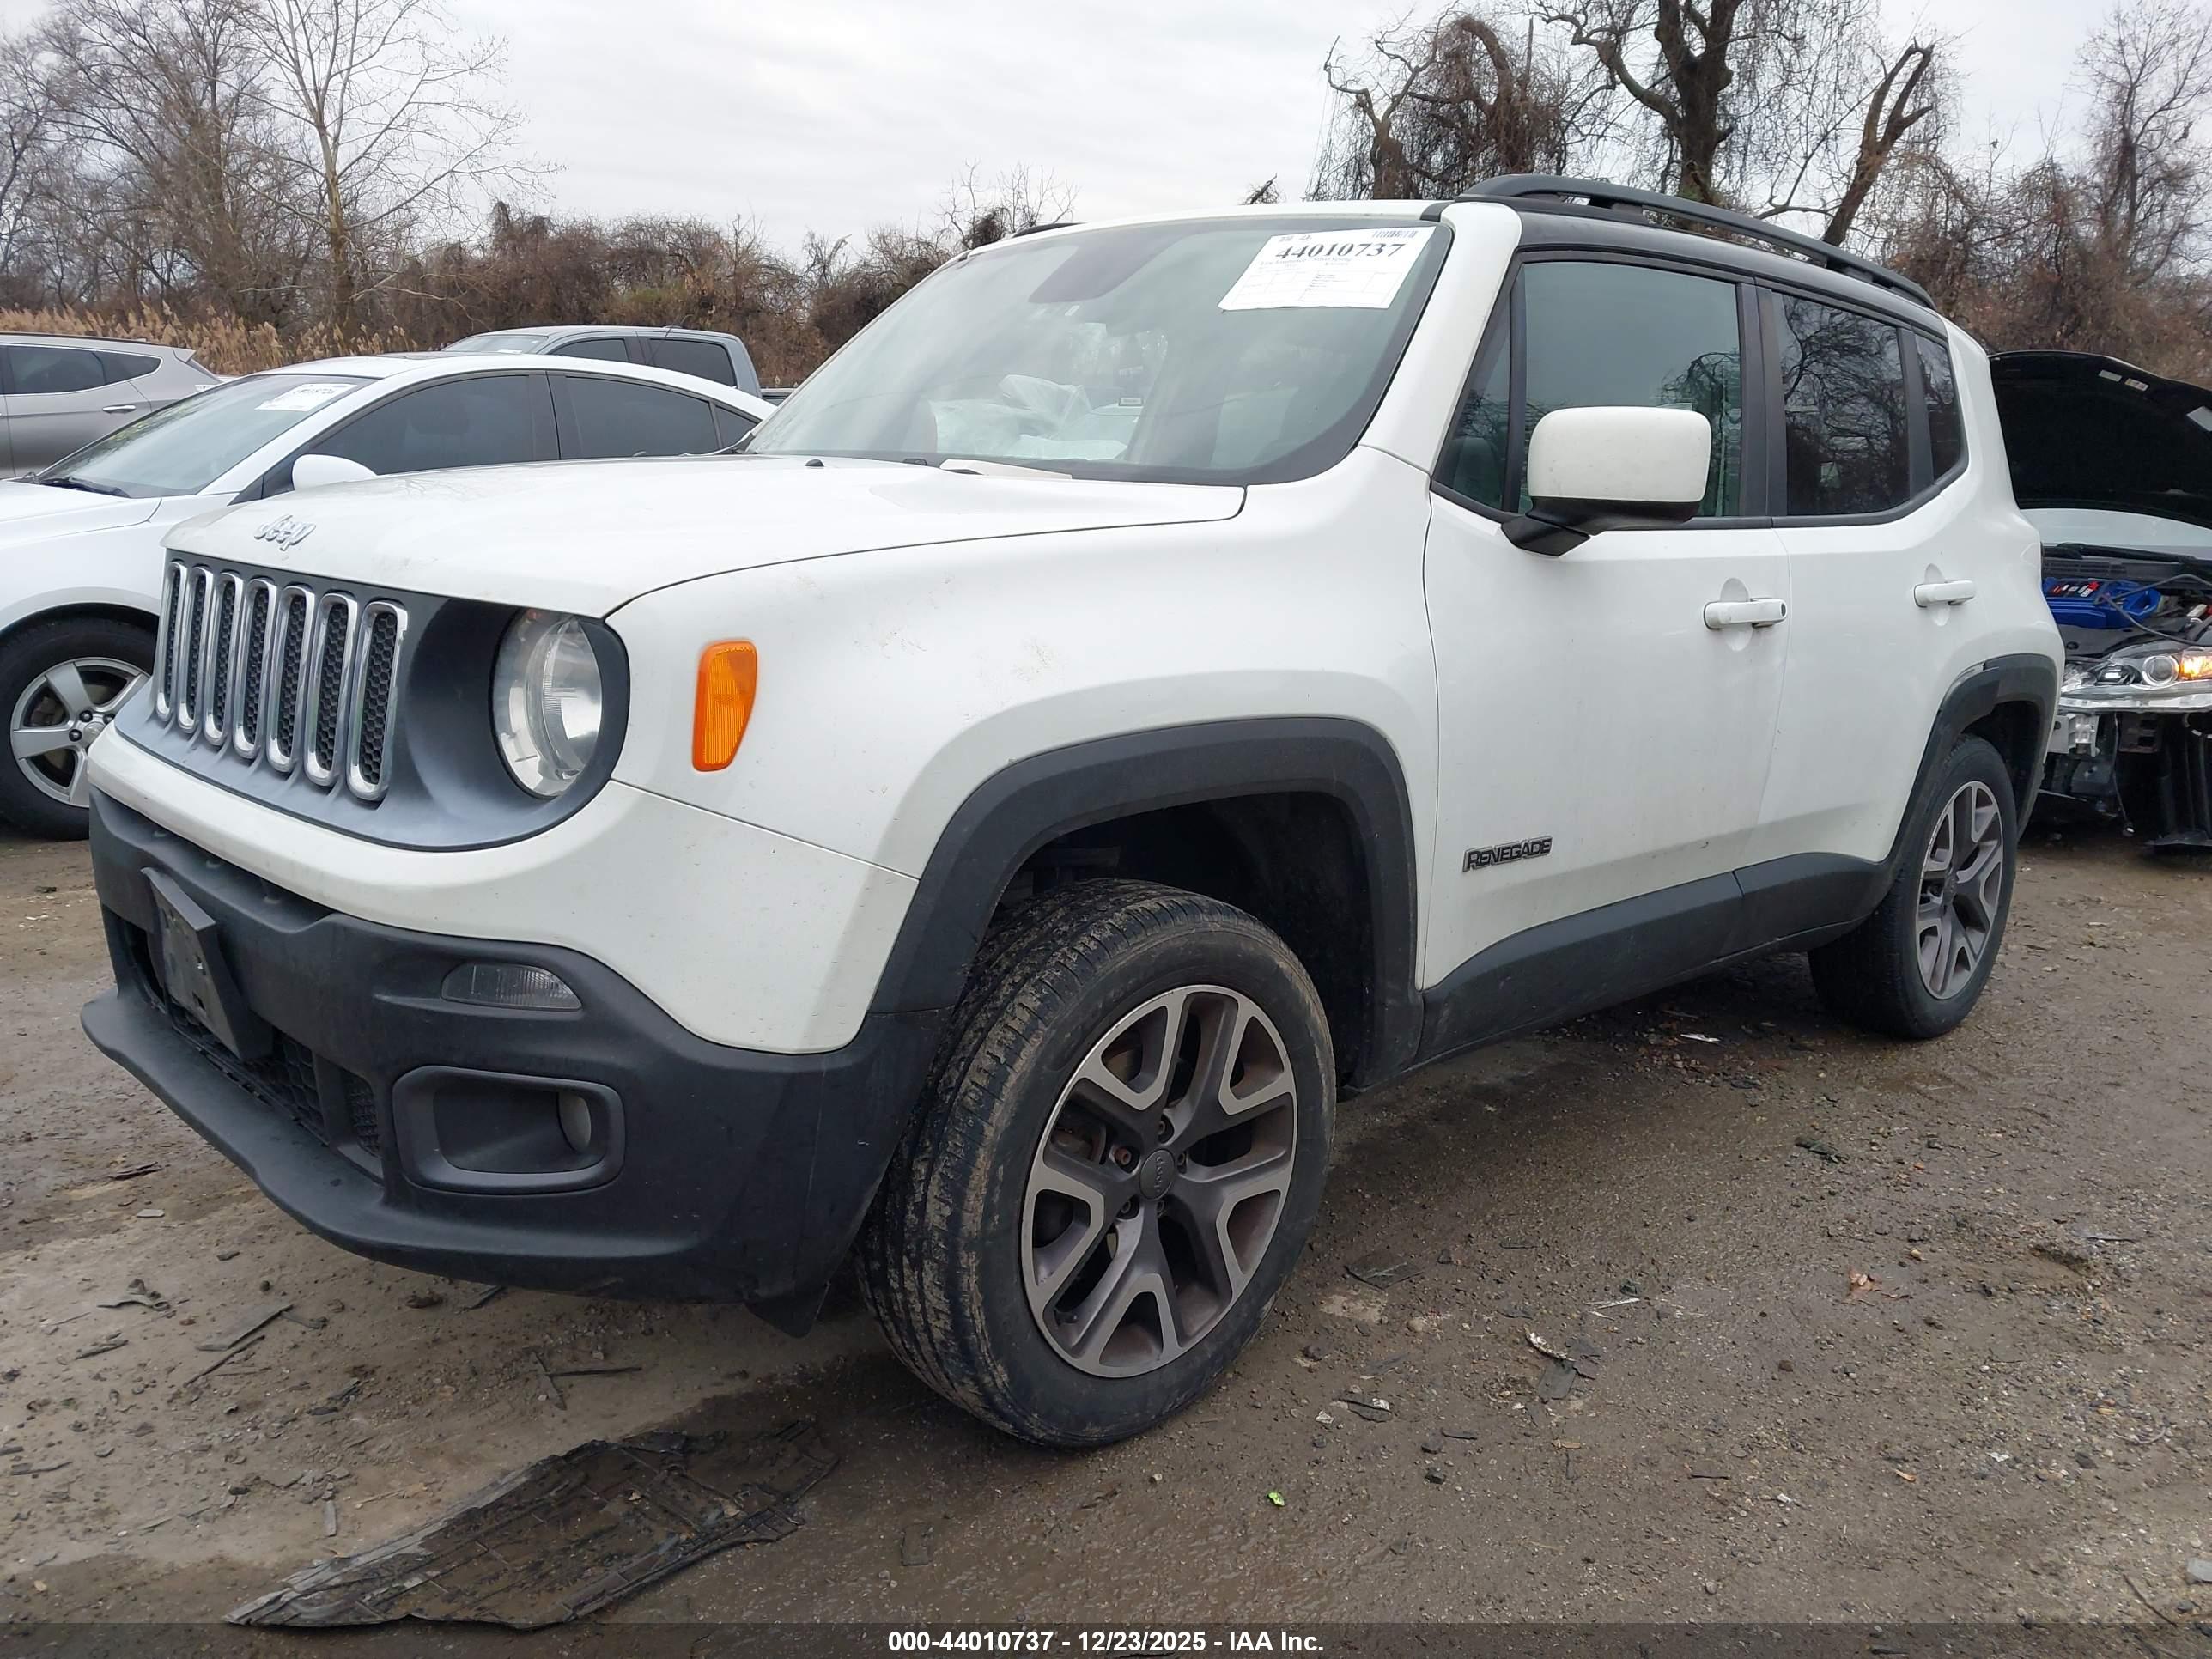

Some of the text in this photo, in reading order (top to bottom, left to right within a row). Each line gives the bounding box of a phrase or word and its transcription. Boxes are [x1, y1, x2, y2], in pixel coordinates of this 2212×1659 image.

[1275, 243, 1405, 258] 44010737
[253, 514, 317, 551] Jeep
[1462, 836, 1553, 872] RENEGADE
